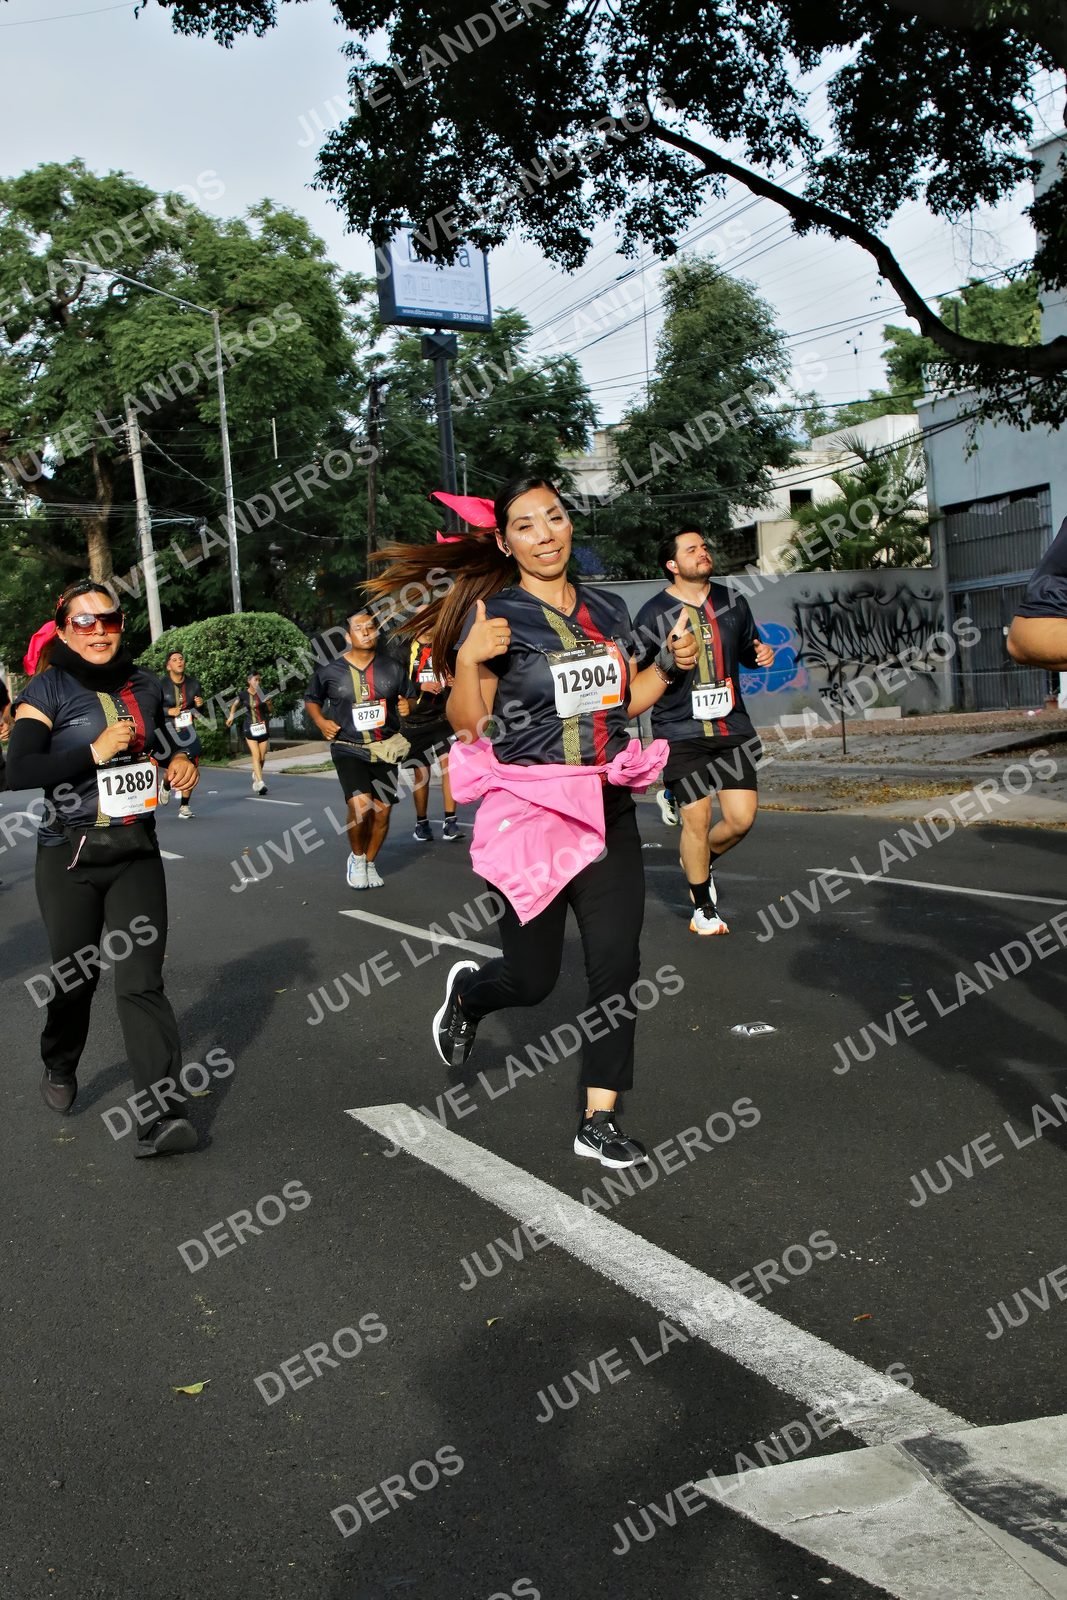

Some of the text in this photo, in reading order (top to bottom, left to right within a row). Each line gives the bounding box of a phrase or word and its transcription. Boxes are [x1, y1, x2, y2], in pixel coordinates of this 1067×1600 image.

[557, 663, 617, 694] 12904
[695, 691, 729, 707] 11771
[358, 709, 380, 720] 8787
[102, 769, 154, 796] 12889
